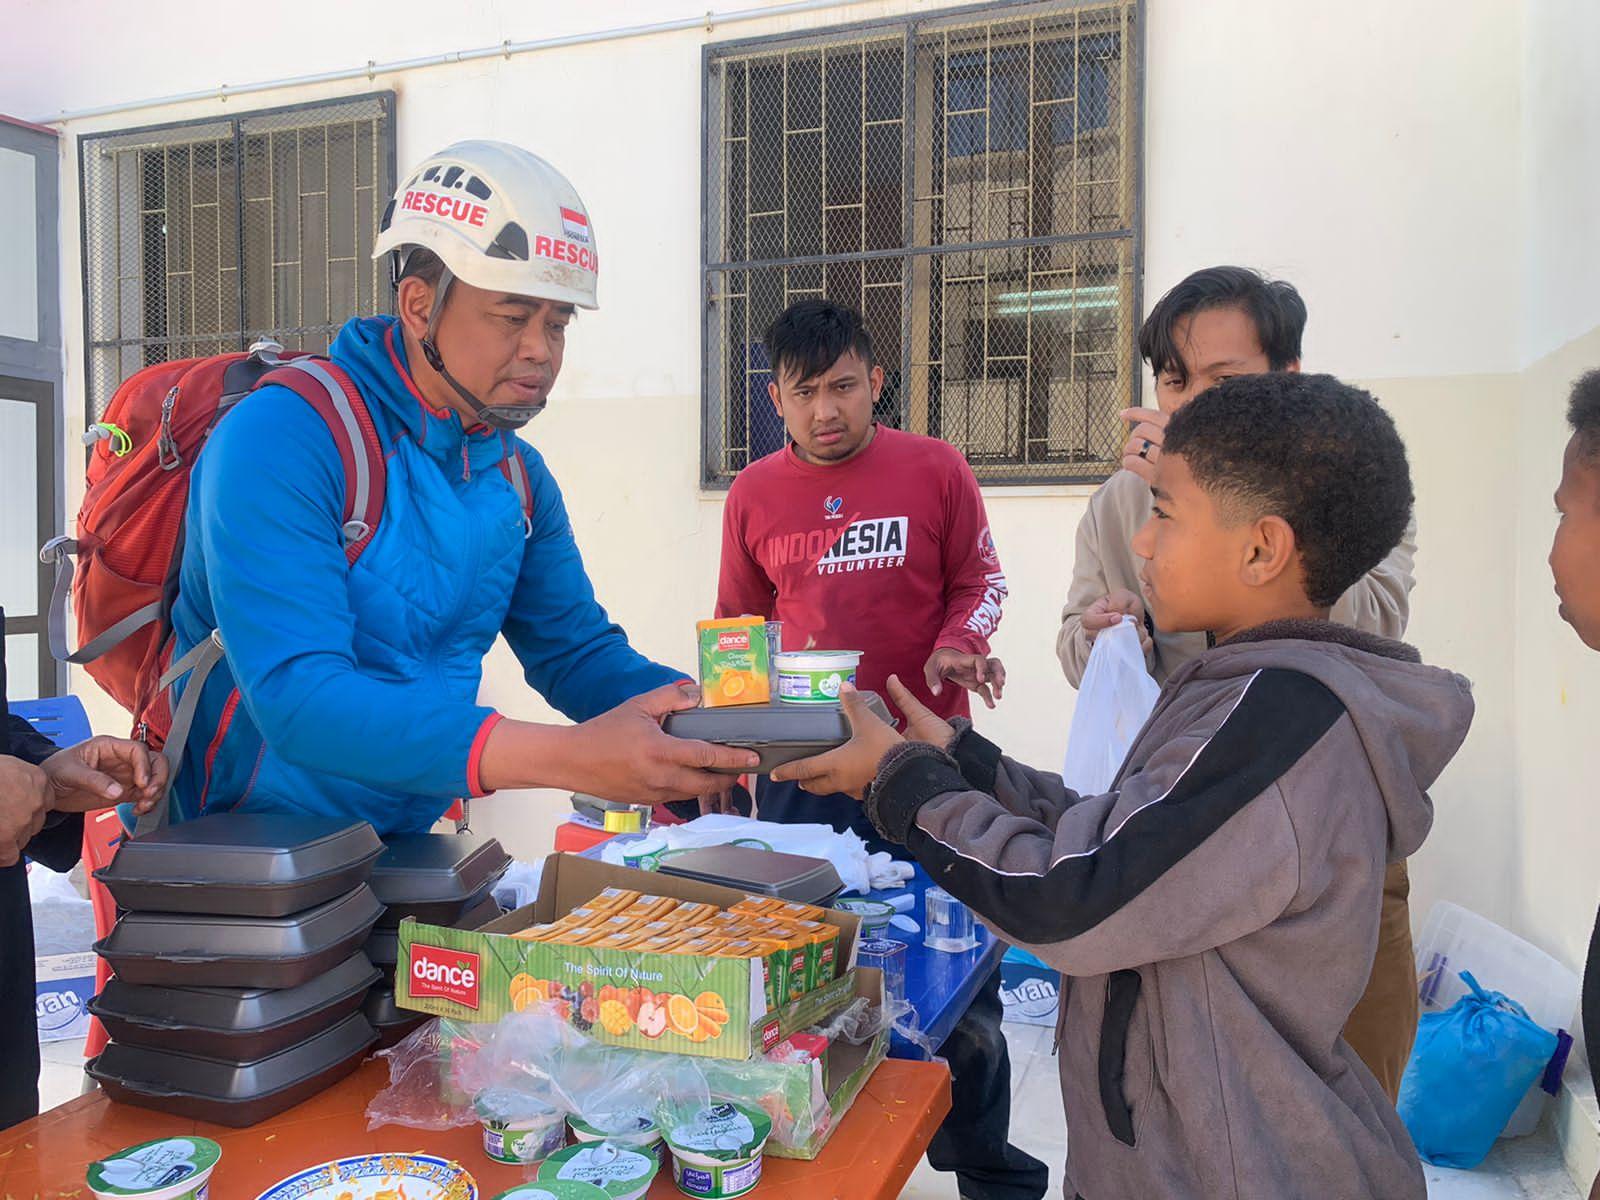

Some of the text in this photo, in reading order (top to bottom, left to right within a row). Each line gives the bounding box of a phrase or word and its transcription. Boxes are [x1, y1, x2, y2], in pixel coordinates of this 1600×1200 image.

[401, 191, 489, 227] RESCUE
[768, 520, 903, 568] INDONESIA
[817, 557, 905, 575] VOLUNTEER
[413, 957, 475, 988] dance
[564, 962, 584, 974] The
[586, 964, 612, 977] Spirit
[615, 967, 628, 978] Of
[36, 990, 80, 1017] van
